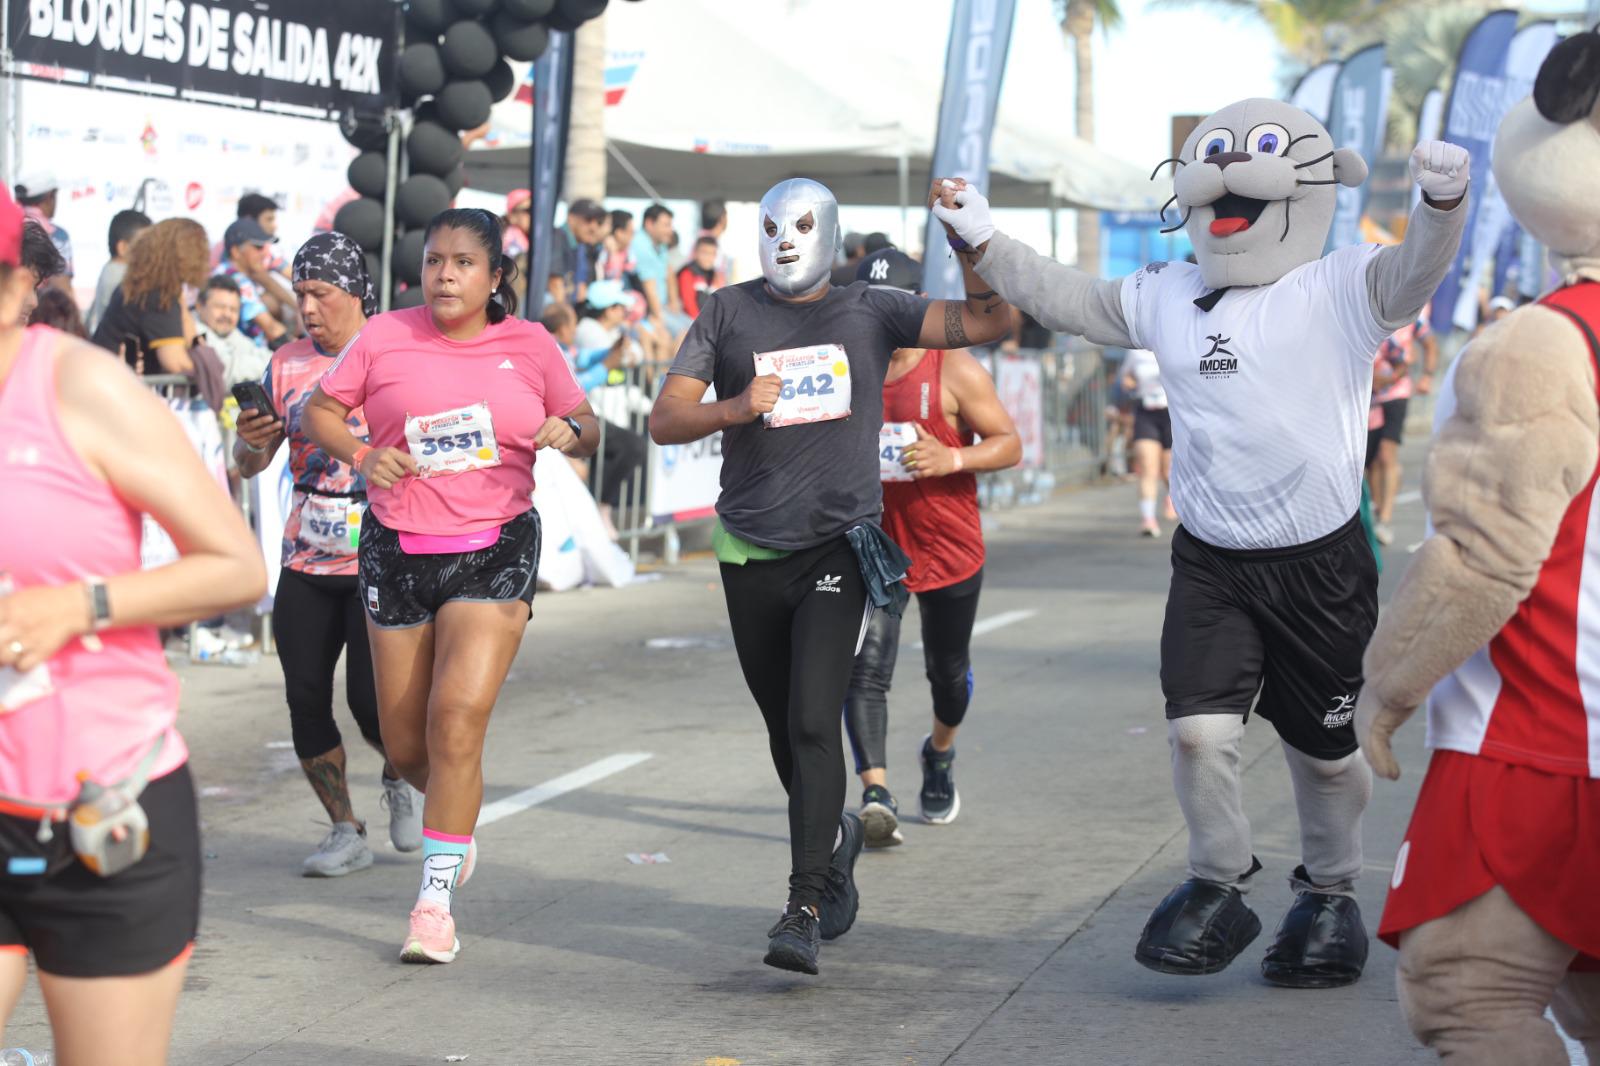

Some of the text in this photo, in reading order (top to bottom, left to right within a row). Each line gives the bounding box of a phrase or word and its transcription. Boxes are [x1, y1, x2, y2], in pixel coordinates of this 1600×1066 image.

[28, 0, 383, 95] BLOQUES DE SALIDA 42K
[1199, 359, 1238, 372] IMDEM
[780, 373, 835, 401] 642
[420, 429, 484, 456] 3631
[309, 518, 348, 538] 676
[815, 585, 841, 593] adidas
